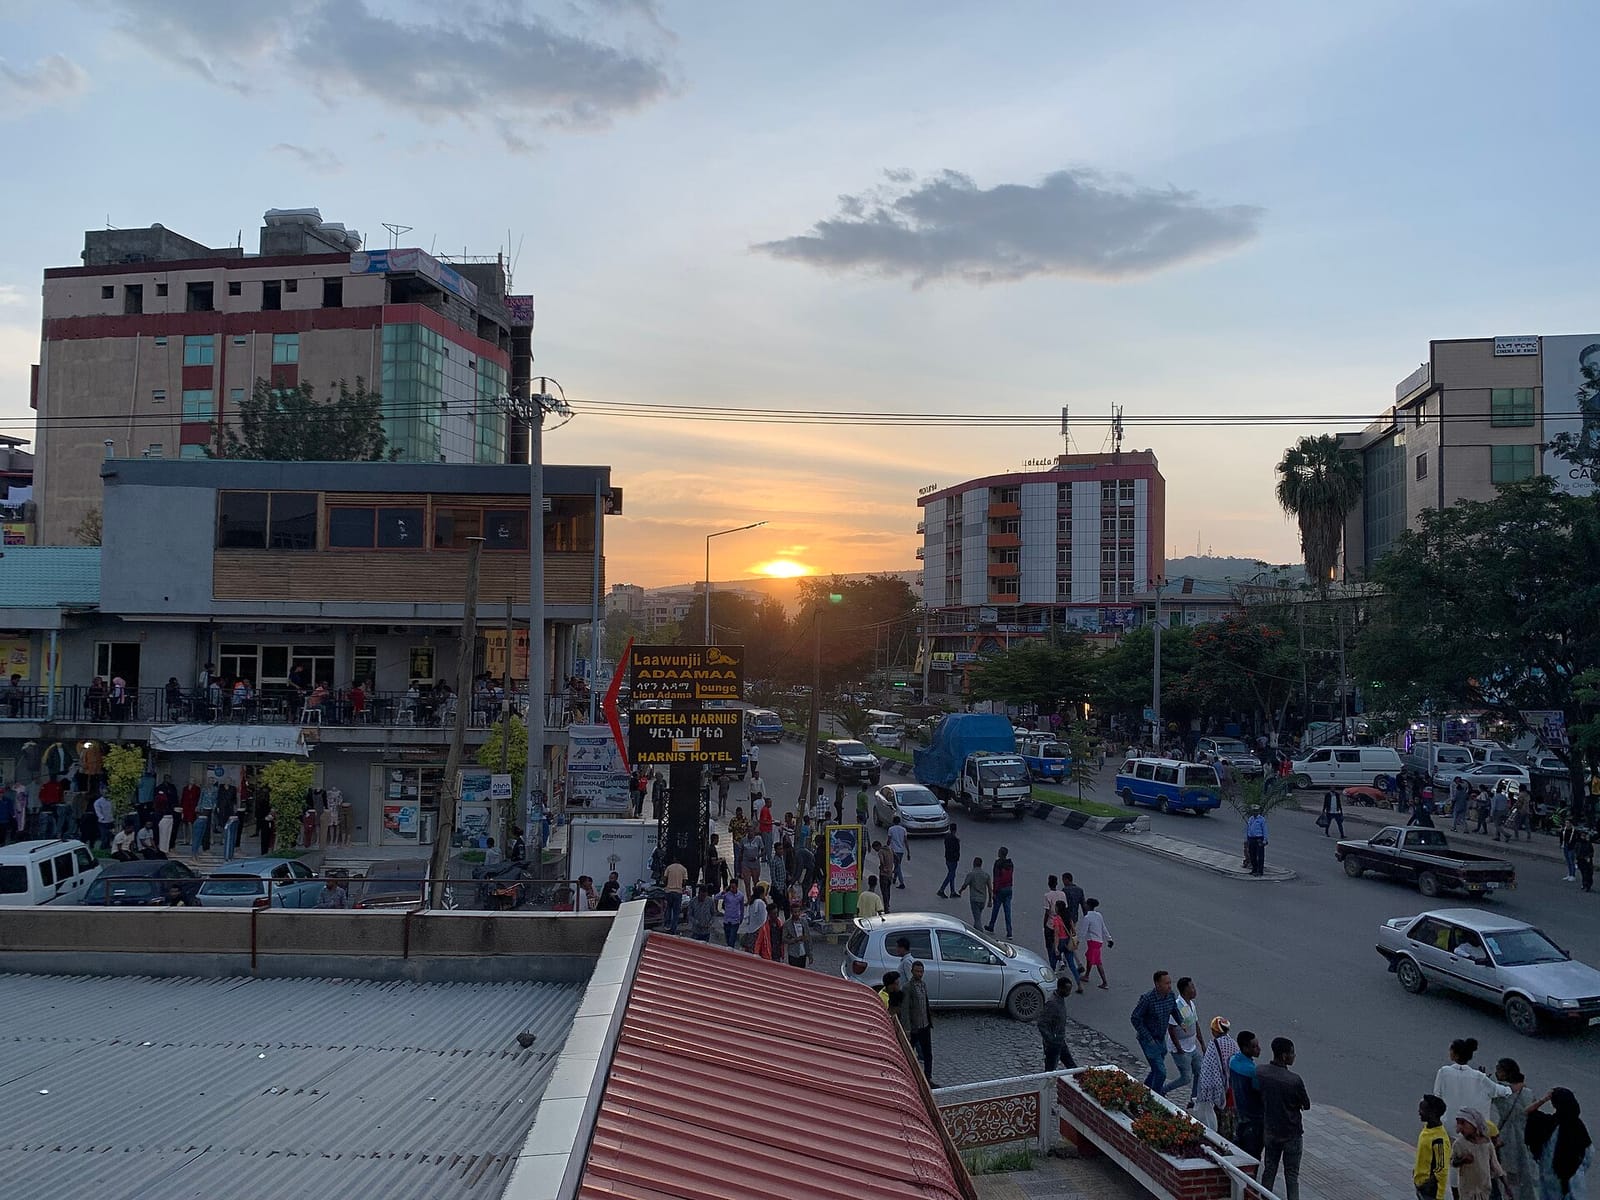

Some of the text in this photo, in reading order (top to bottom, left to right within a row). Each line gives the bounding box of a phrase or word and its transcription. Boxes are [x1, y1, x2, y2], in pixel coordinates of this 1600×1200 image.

[633, 653, 701, 669] Laawunjii
[638, 670, 737, 679] ADAAMAA
[633, 691, 692, 699] Lion Adama
[695, 681, 739, 700] Lounge
[635, 713, 738, 725] HOTEELA HARNIIS
[692, 727, 723, 738] ሆቴል
[638, 752, 733, 762] HARNIS HOTEL
